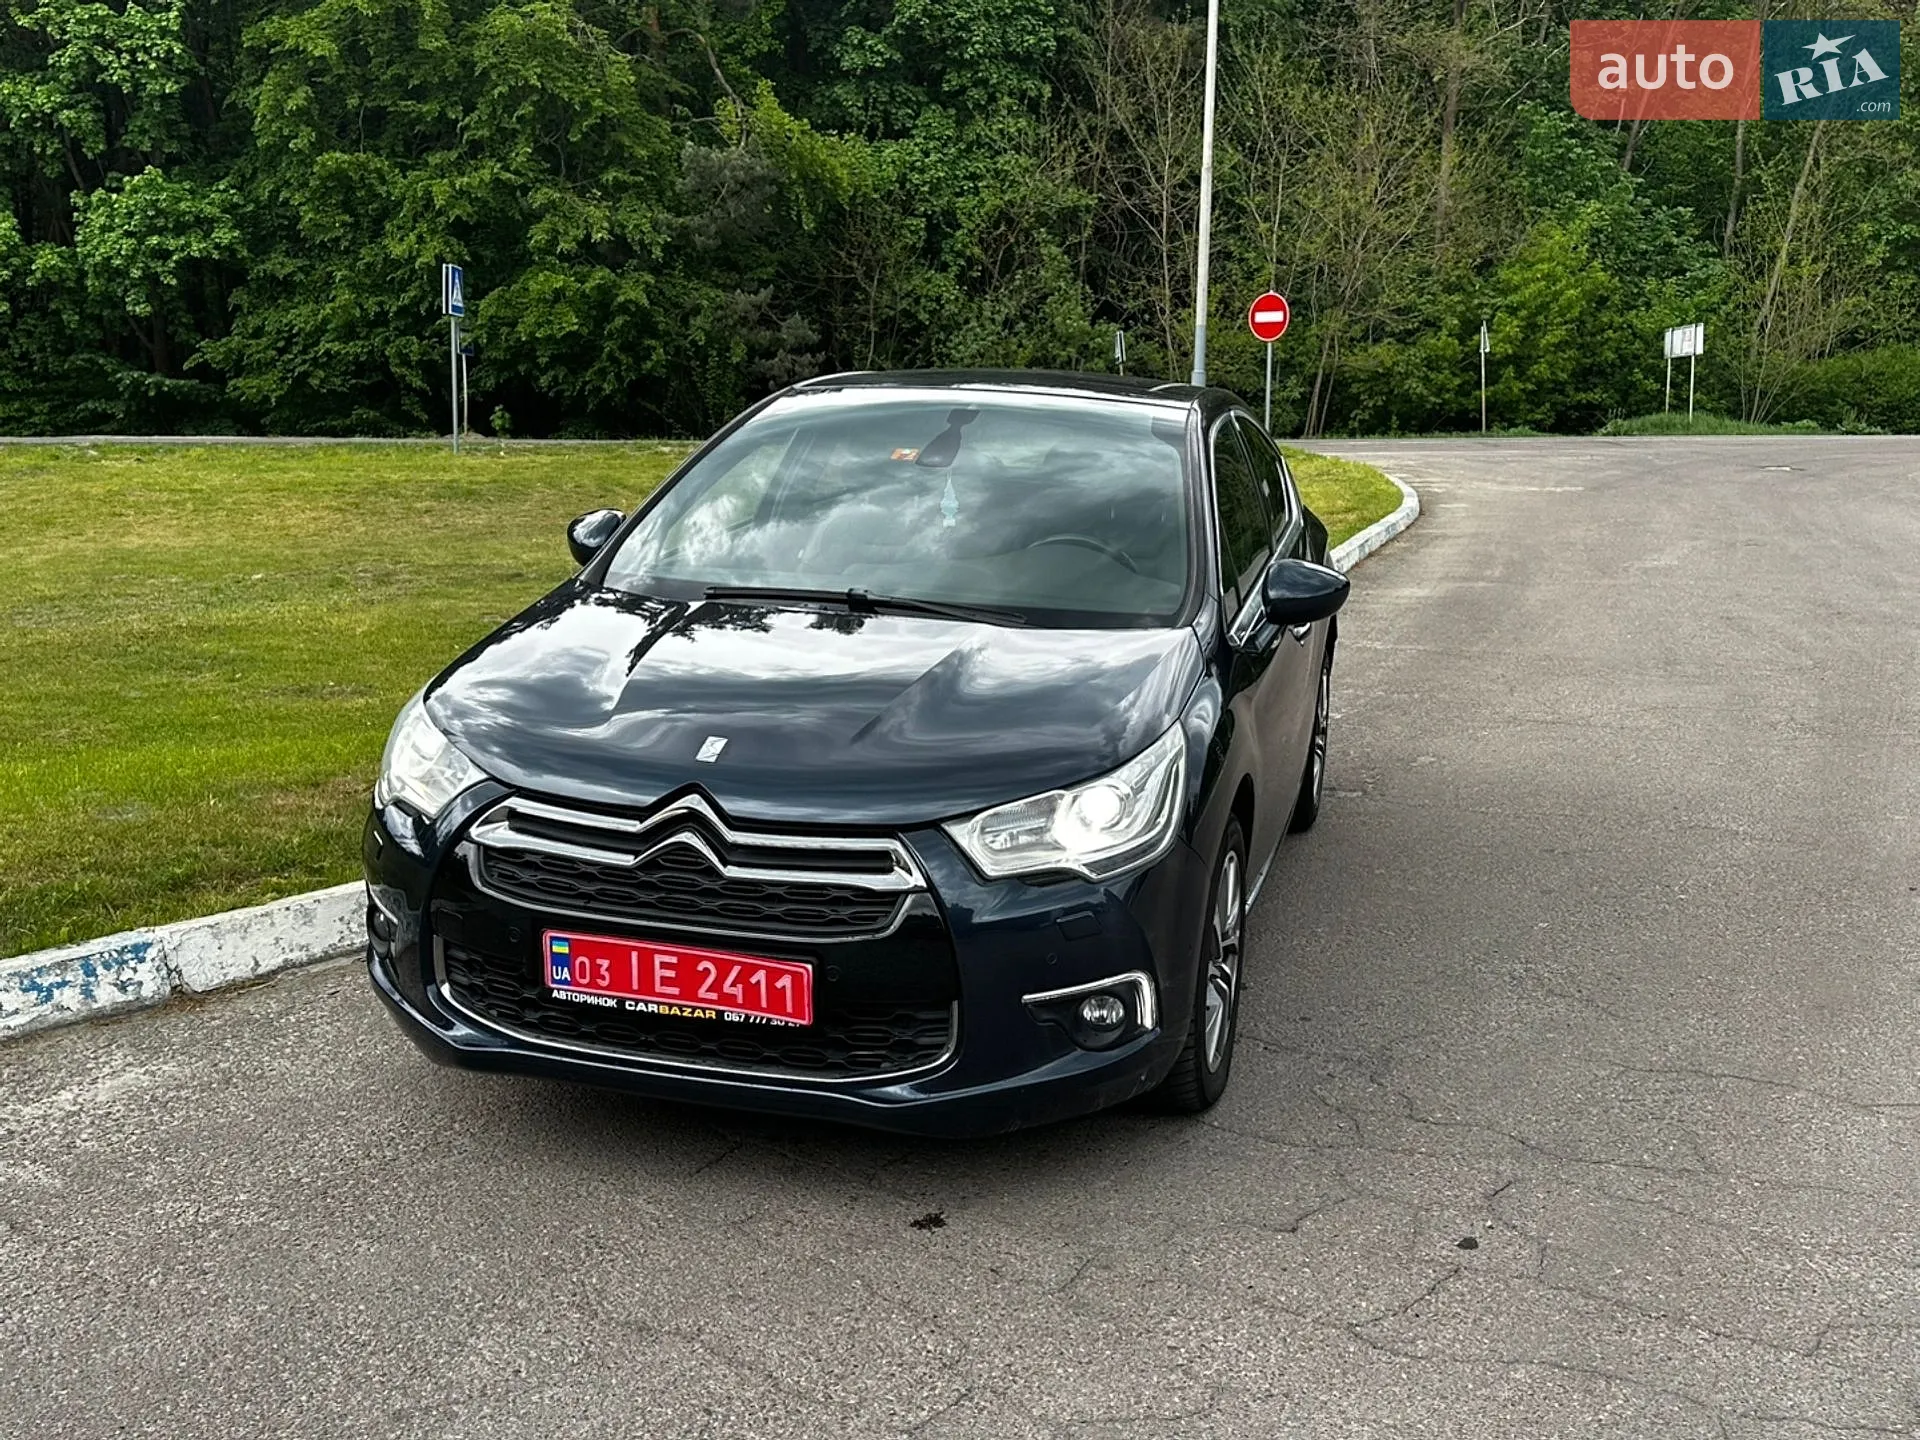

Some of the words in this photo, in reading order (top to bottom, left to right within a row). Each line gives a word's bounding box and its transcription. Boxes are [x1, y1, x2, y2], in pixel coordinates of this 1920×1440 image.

[552, 965, 571, 982] UA
[574, 955, 611, 987] 03
[696, 960, 793, 1014] 2411
[552, 989, 617, 1008] АВТОРИНОК
[625, 1000, 717, 1020] CARBAZAR
